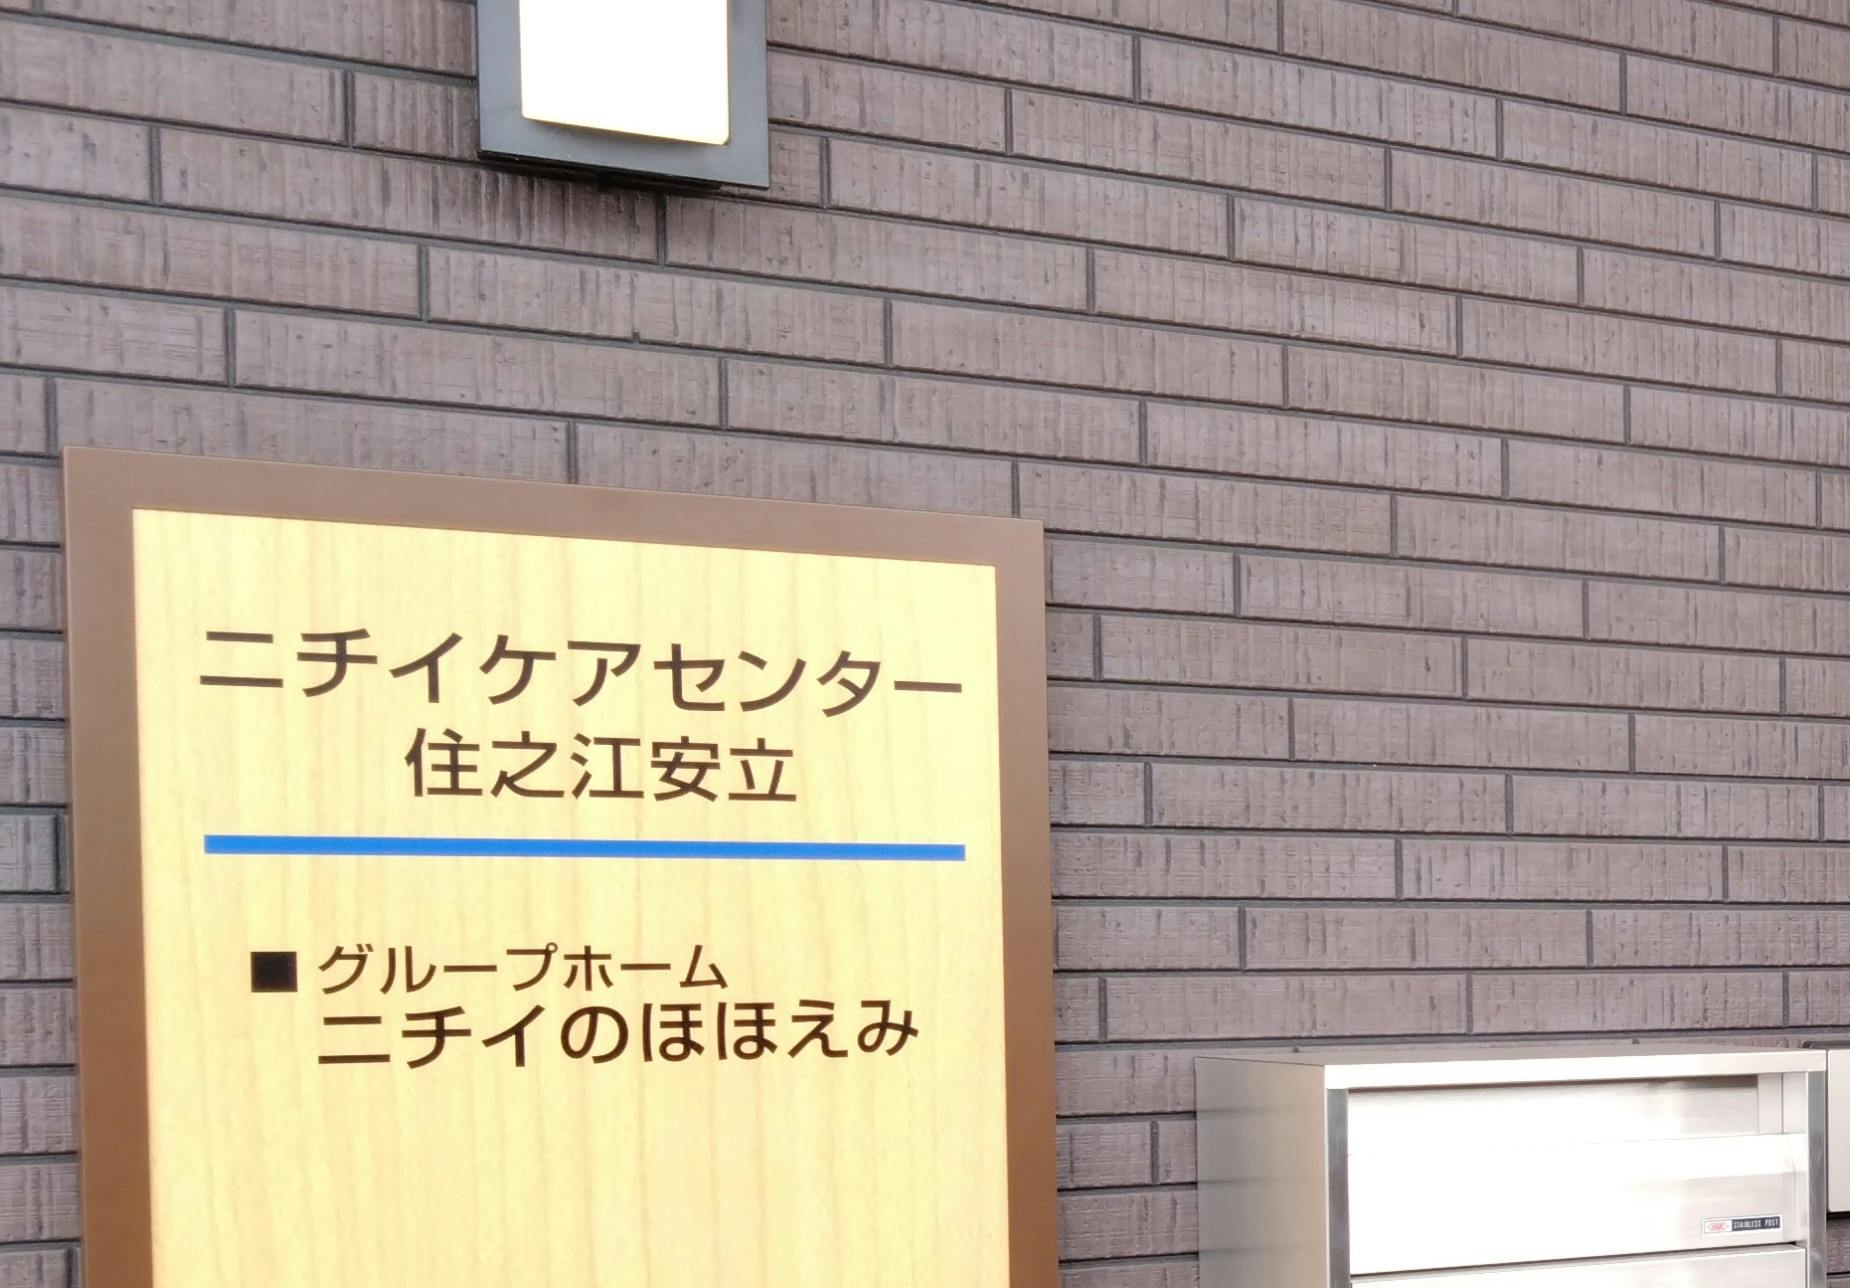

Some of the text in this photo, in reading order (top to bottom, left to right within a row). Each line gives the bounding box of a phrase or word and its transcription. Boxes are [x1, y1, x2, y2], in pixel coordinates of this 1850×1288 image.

[200, 629, 964, 718] ニチイケアセンター
[404, 727, 798, 803] 住之江安立
[317, 943, 729, 994] グループホーム
[317, 999, 921, 1070] ニチイのほほえみ
[1733, 1219, 1762, 1230] STAINLESS
[1764, 1217, 1779, 1228] POST
